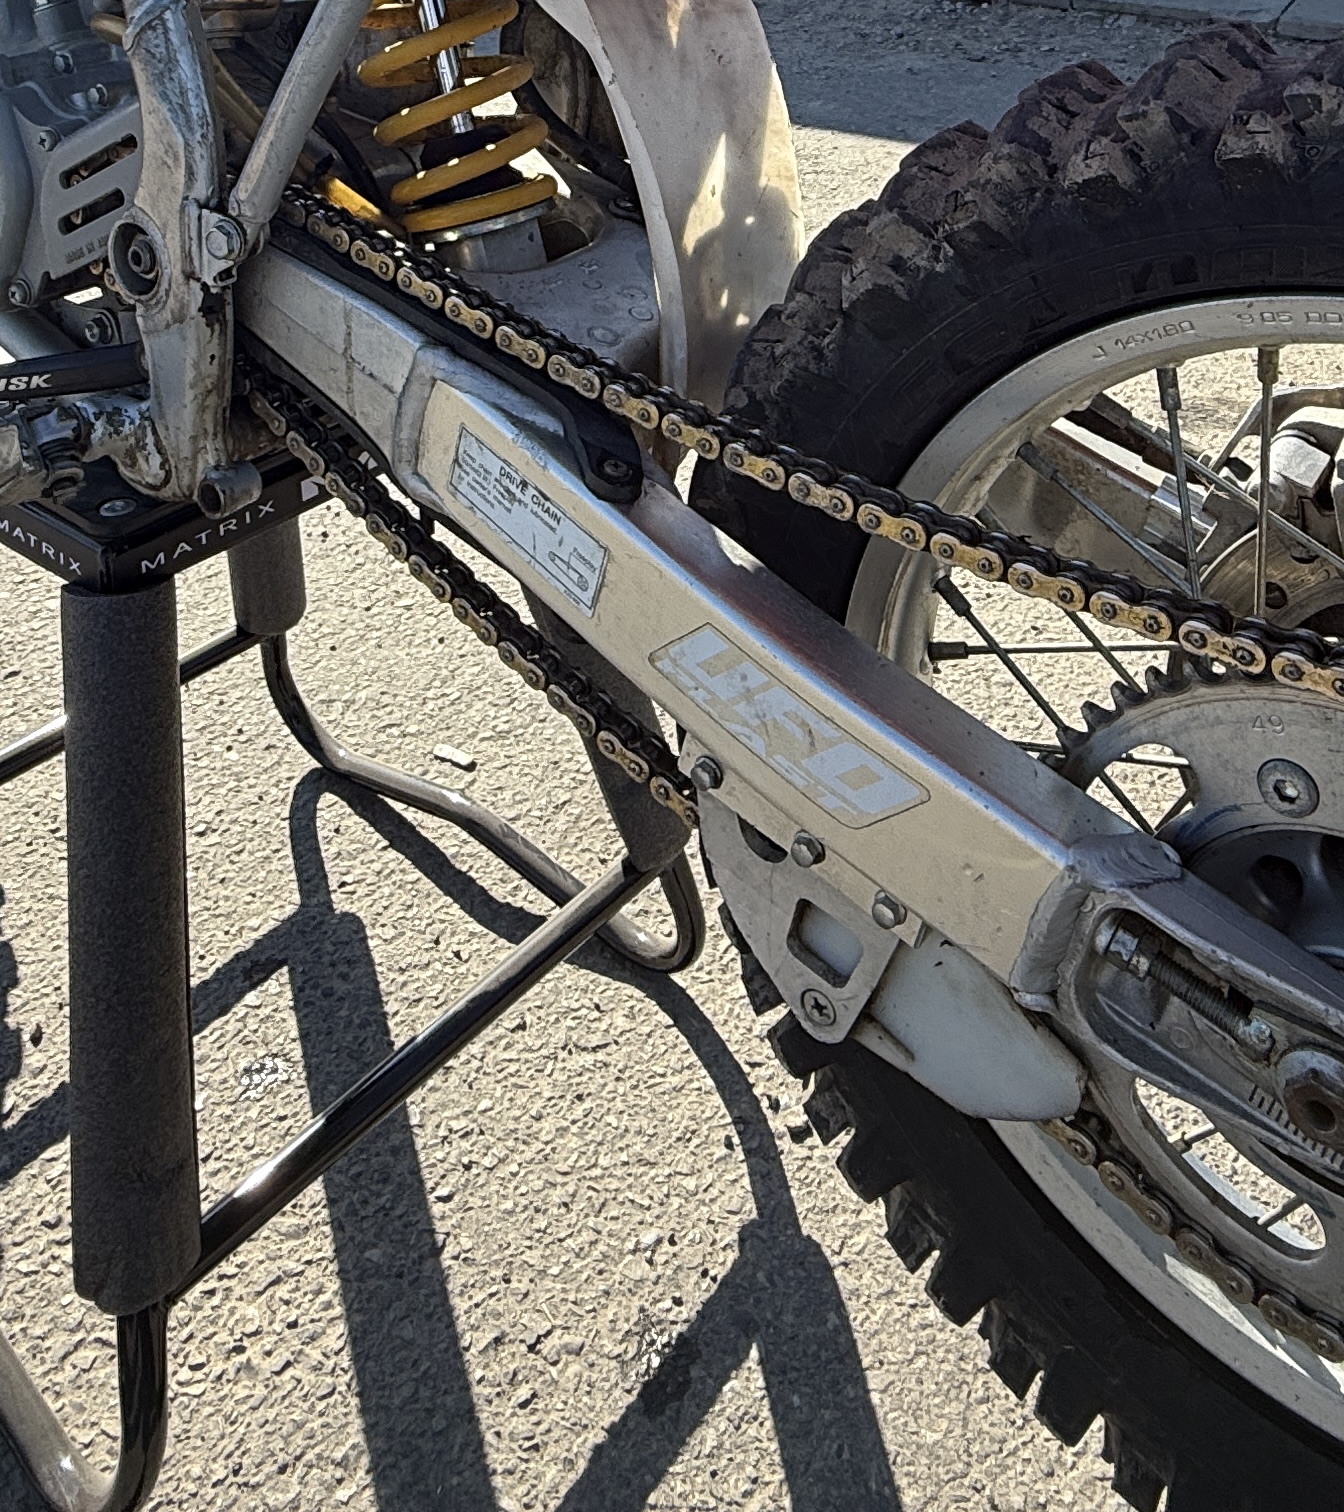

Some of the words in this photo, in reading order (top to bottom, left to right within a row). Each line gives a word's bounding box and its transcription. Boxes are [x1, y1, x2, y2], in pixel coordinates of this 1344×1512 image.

[499, 465, 528, 496] DRIVE
[531, 493, 562, 527] CHAIN
[140, 500, 276, 574] MATRIX
[668, 630, 921, 815] UFO
